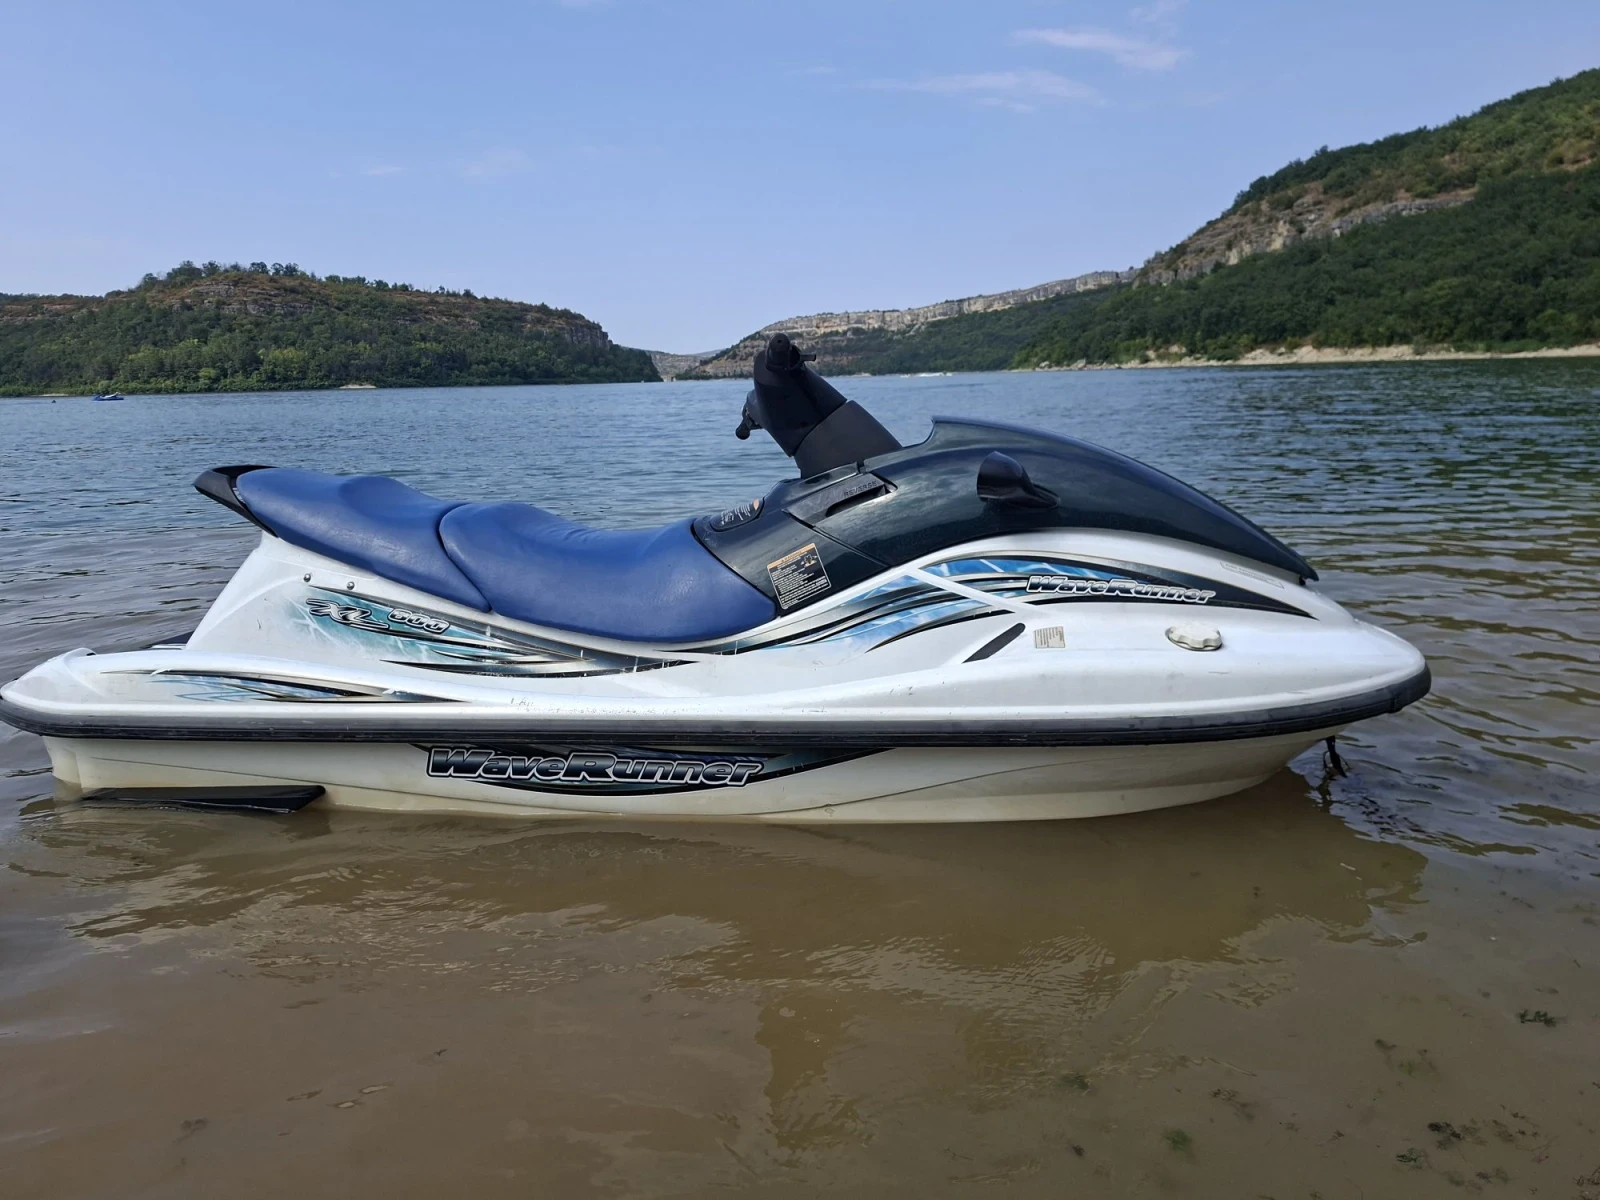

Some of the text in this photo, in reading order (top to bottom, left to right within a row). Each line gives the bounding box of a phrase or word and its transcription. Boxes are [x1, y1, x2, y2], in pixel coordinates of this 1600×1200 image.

[843, 480, 878, 498] REVERSE
[1026, 575, 1217, 604] WaveRunner
[306, 598, 390, 630] XL
[426, 748, 765, 788] WaveRunner
